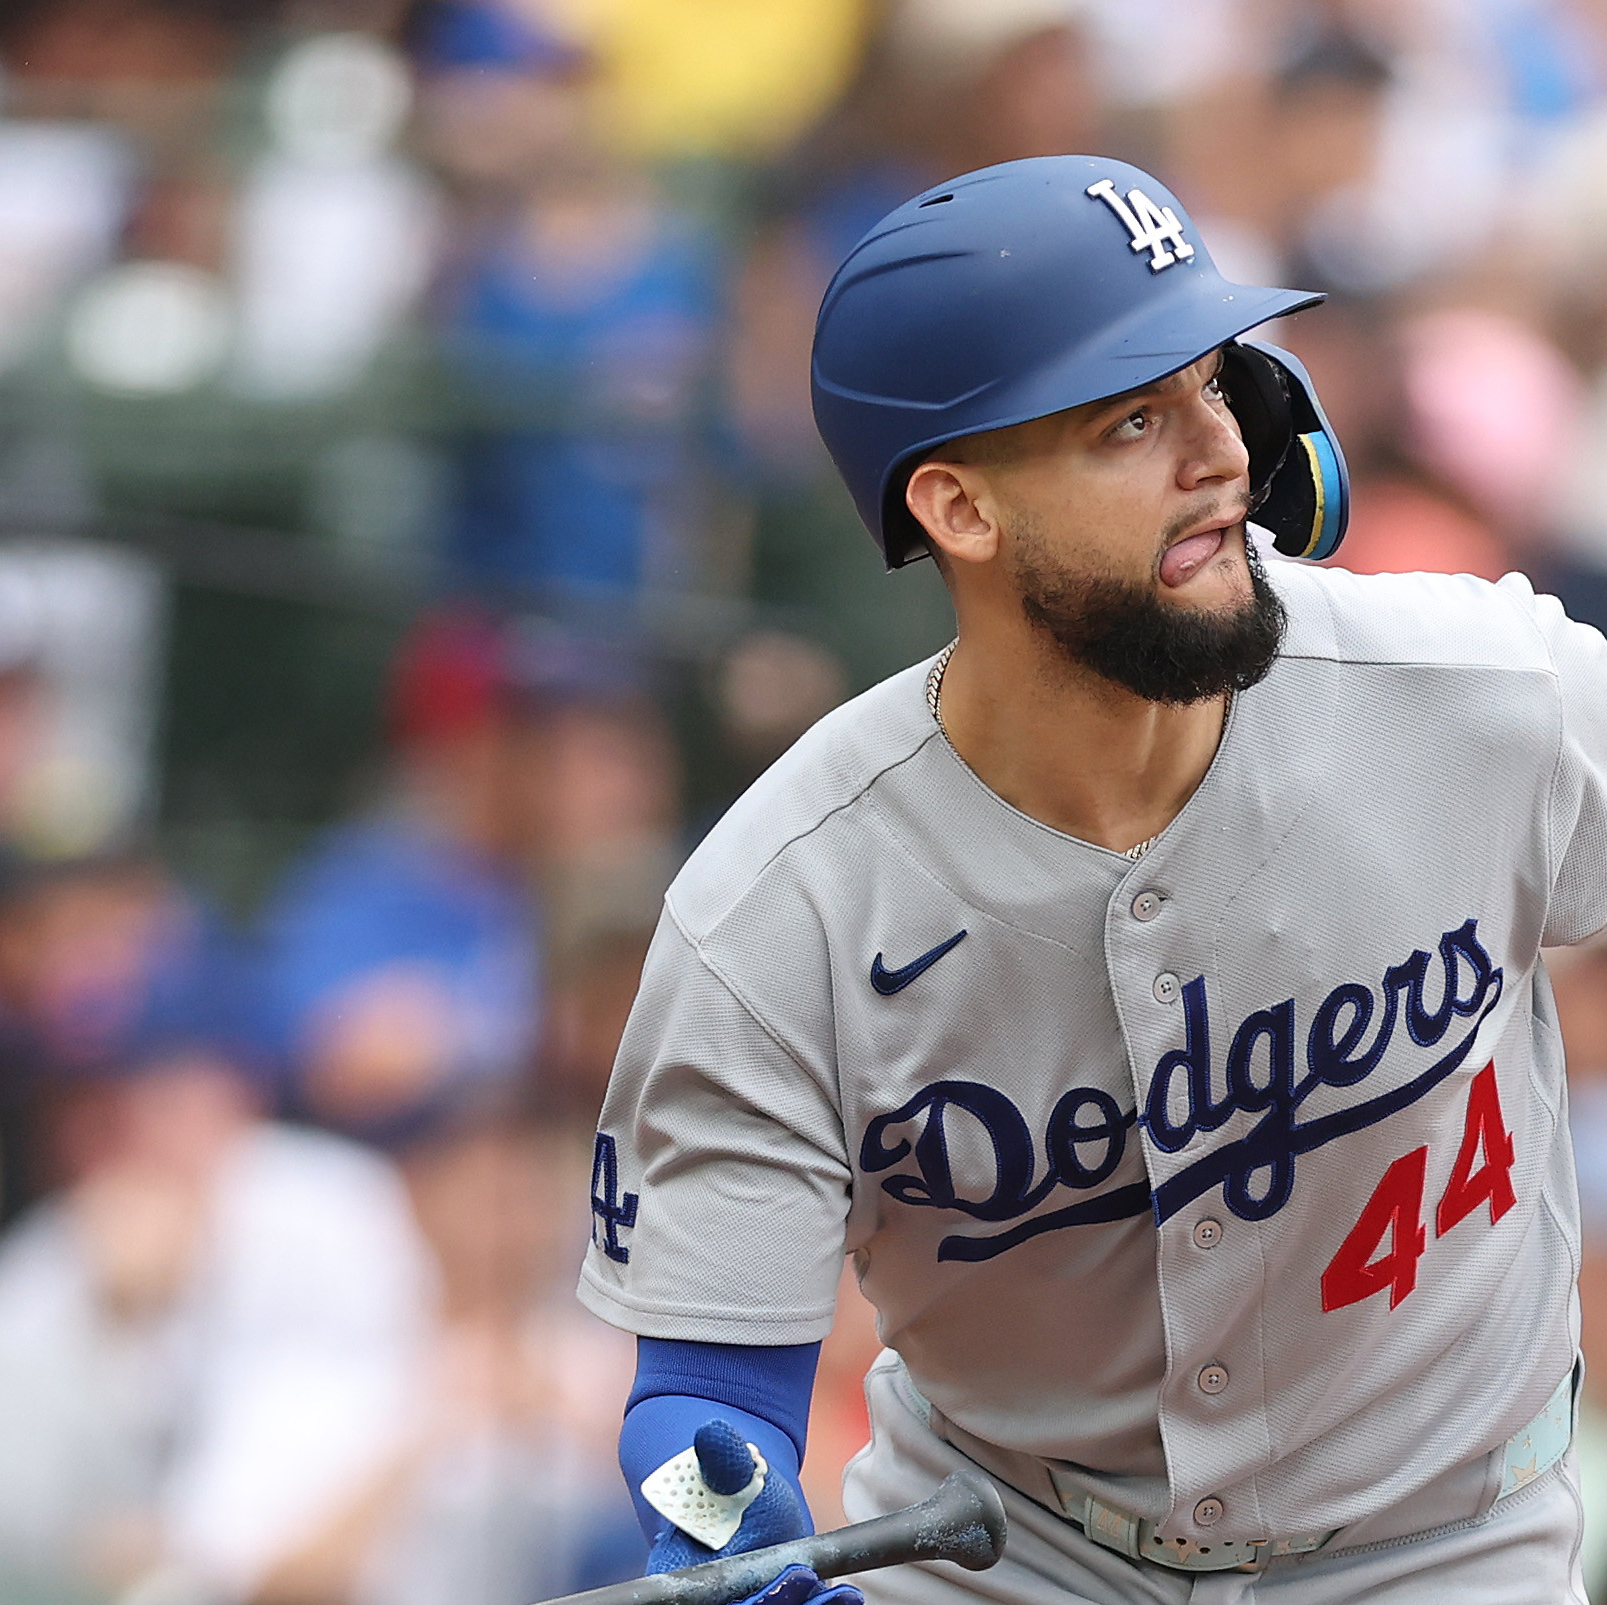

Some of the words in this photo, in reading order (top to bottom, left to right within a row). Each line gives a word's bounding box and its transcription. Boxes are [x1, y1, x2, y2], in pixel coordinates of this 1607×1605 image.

[1085, 178, 1195, 274] LA
[859, 918, 1504, 1224] Dodgers
[1320, 1057, 1516, 1313] 44
